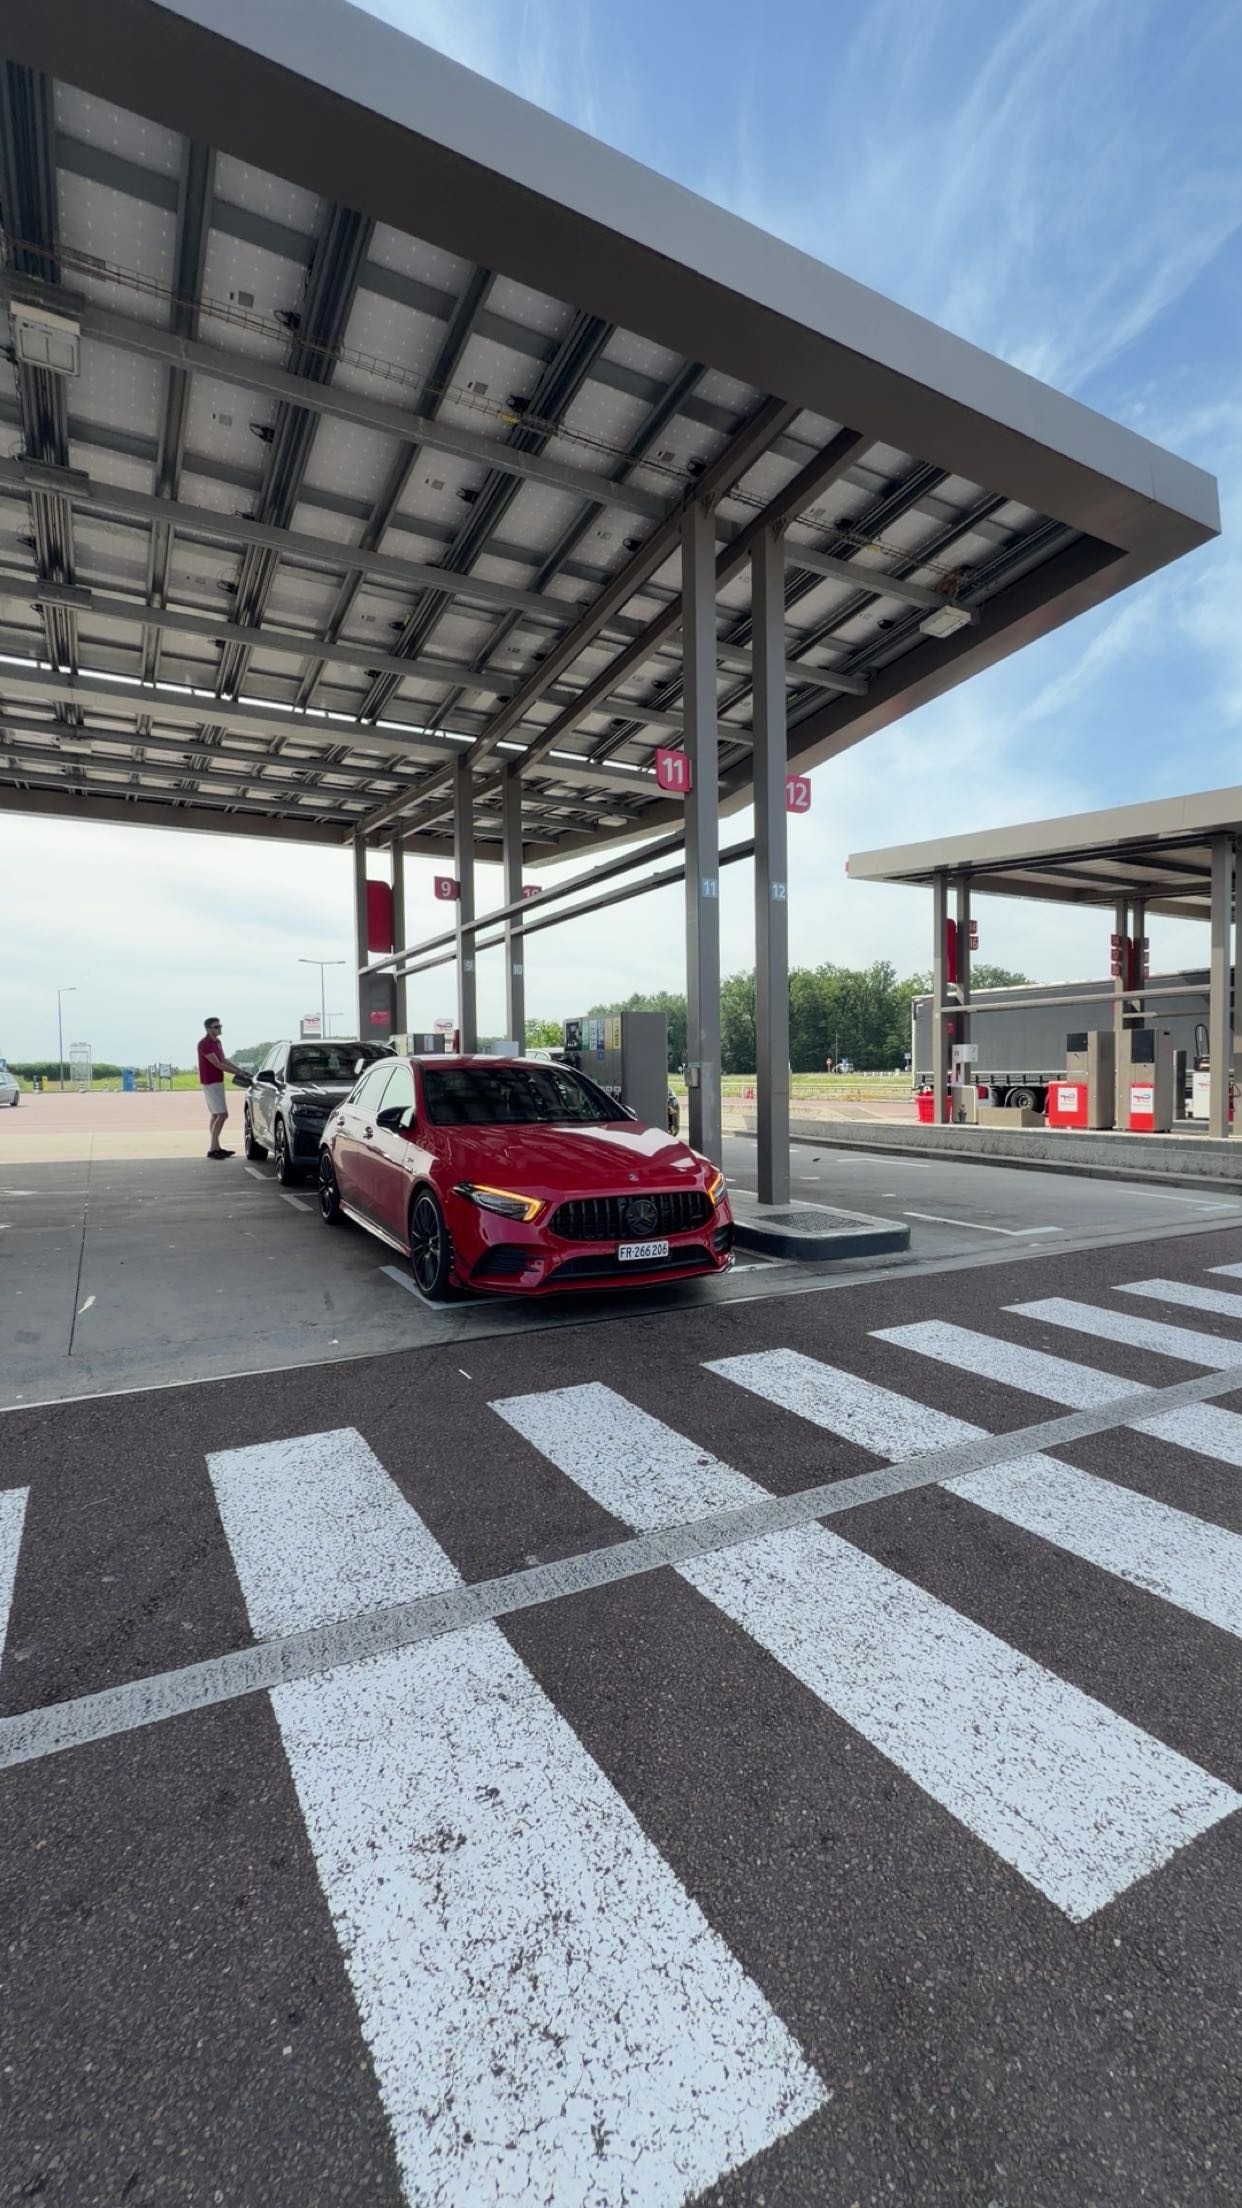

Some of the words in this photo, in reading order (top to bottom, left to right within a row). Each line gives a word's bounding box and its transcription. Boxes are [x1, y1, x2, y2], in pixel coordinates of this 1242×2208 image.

[662, 758, 683, 784] 11
[786, 782, 808, 806] 12
[441, 881, 451, 896] 9
[703, 880, 716, 896] 11
[772, 884, 786, 899] 12
[465, 961, 473, 971] 9
